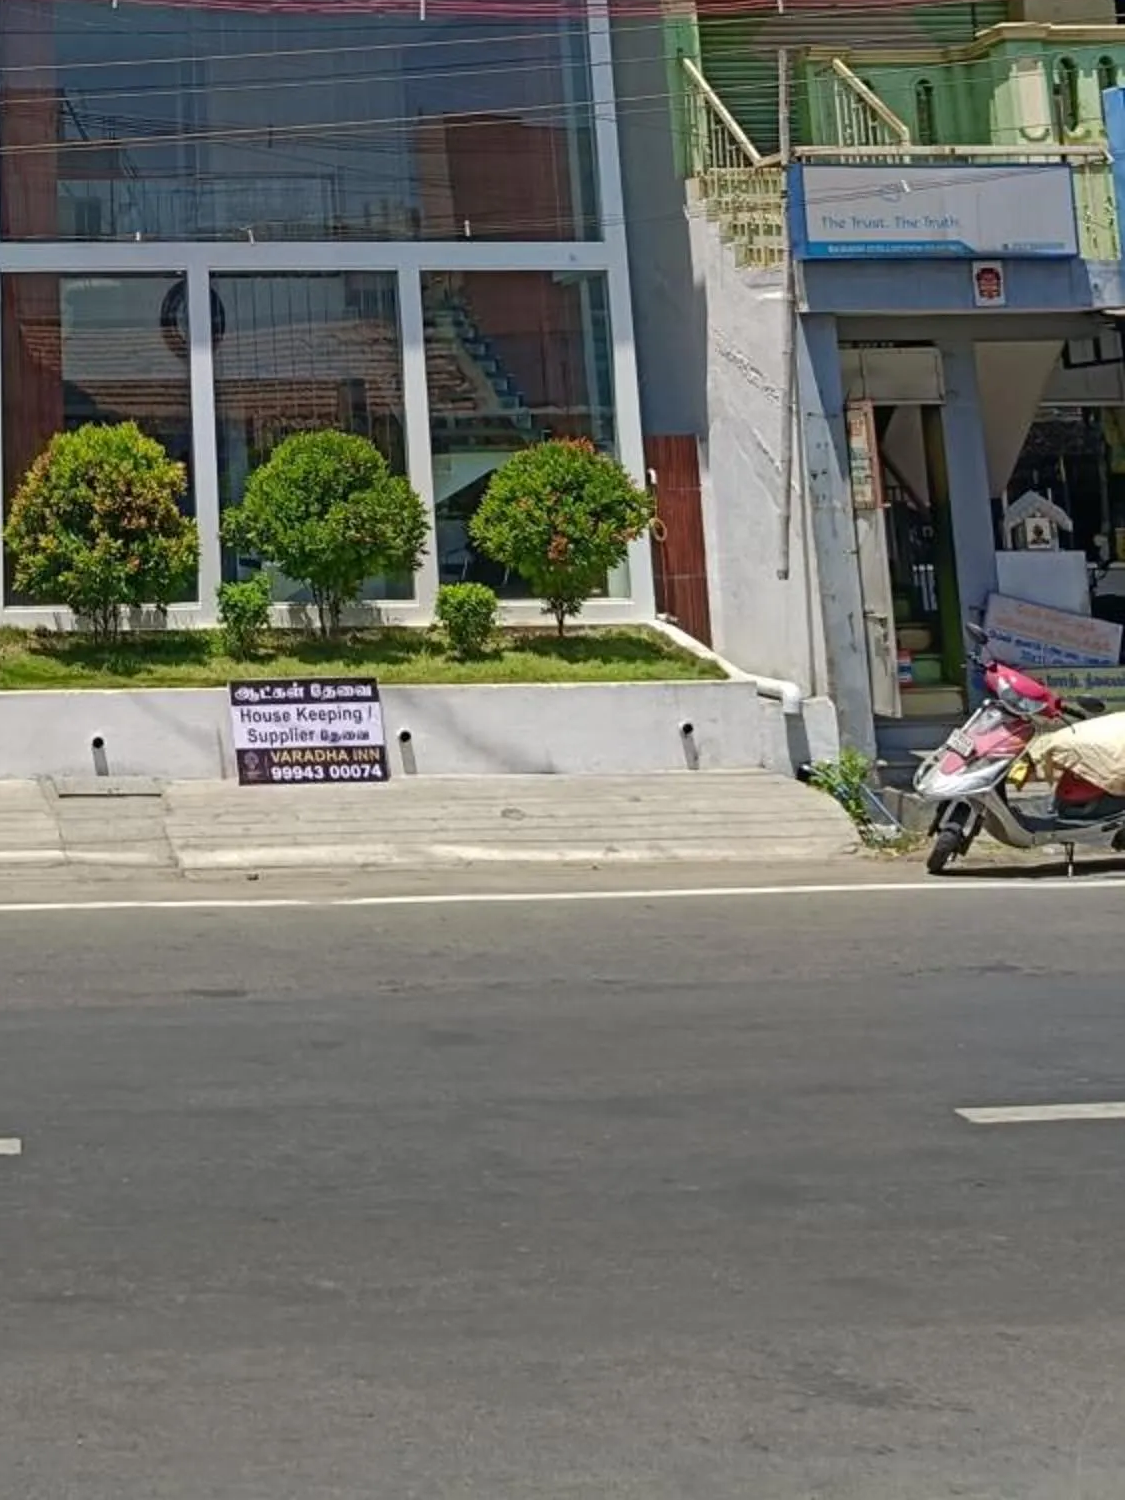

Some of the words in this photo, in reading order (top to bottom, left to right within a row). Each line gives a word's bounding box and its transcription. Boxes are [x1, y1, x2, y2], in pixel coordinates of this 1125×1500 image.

[235, 682, 305, 701] ஆட்கள்
[310, 682, 372, 700] தேவை
[240, 709, 291, 722] House
[296, 707, 363, 724] Keeping
[248, 728, 315, 744] Supplier
[271, 749, 349, 763] VARADHA
[352, 748, 380, 761] INN
[271, 765, 324, 780] 99943
[329, 764, 382, 779] 00074
